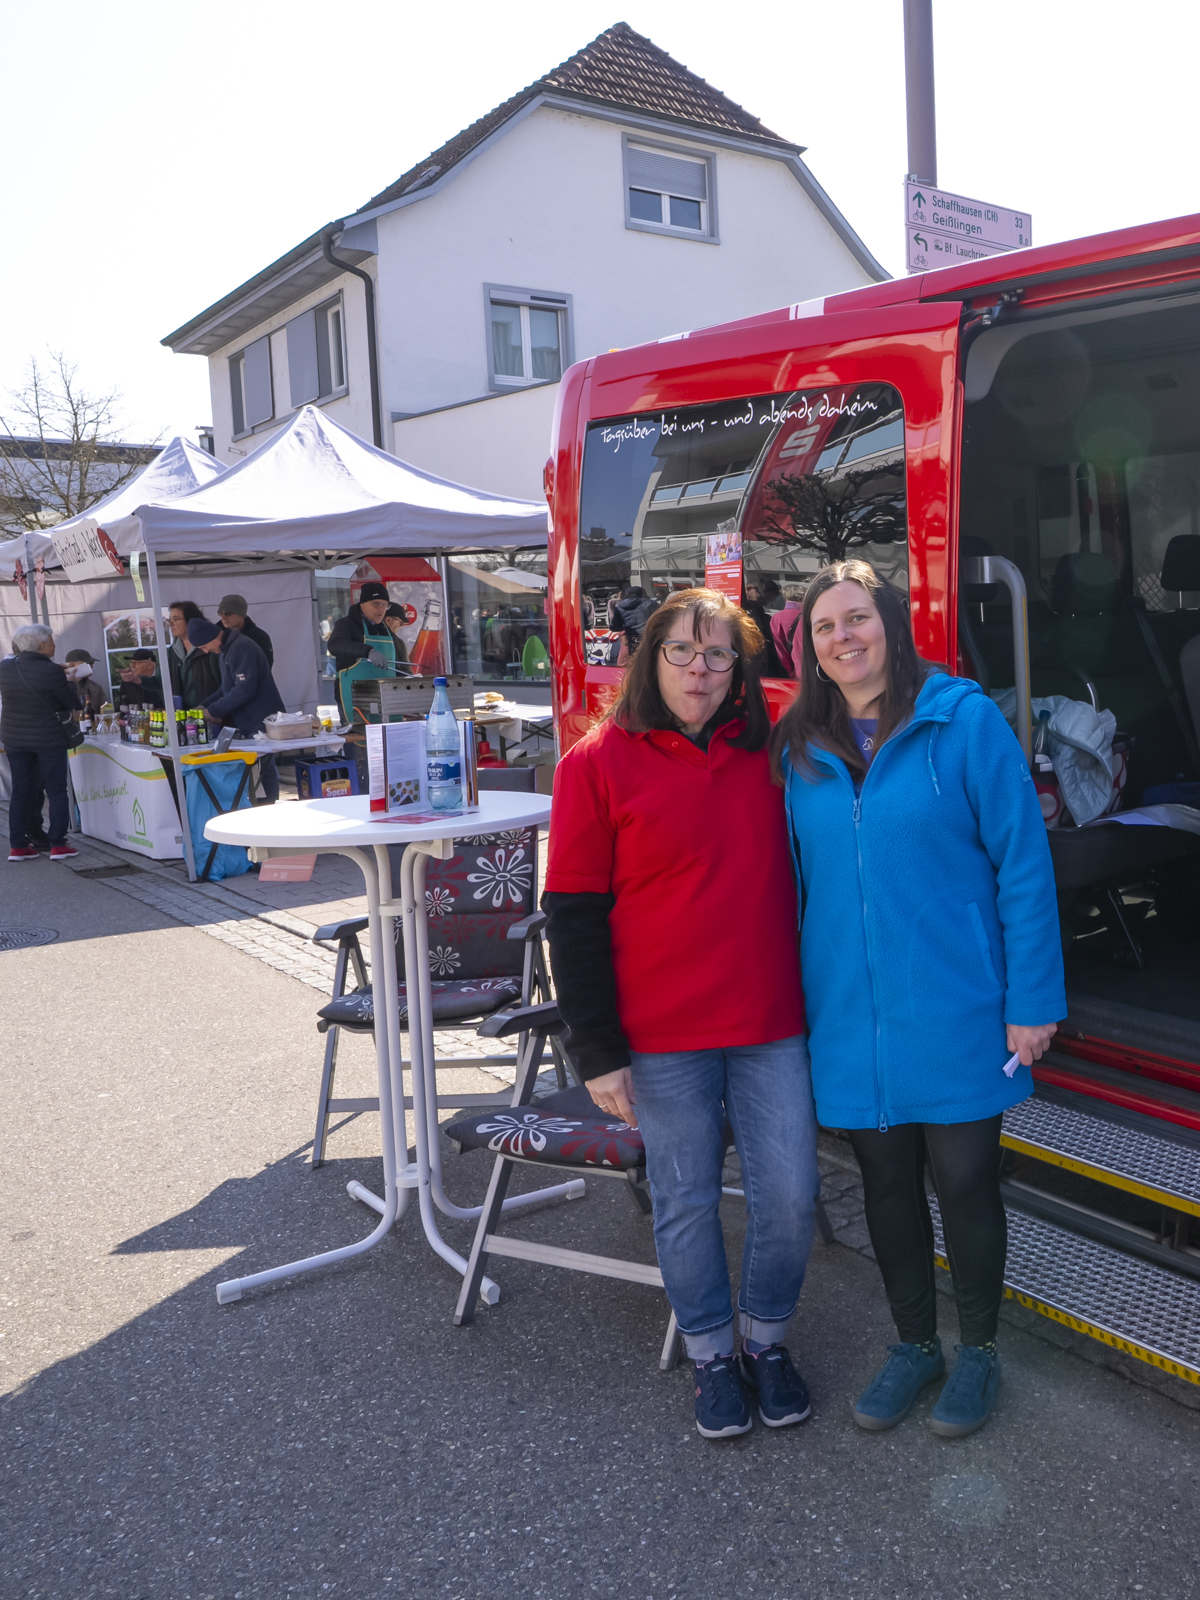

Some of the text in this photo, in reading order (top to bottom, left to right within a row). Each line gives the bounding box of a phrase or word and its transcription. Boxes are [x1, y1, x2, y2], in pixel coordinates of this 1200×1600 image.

[932, 195, 1022, 228] Schaffhausen (CH) 33
[932, 212, 982, 235] Geißlingen
[944, 242, 991, 259] Bf. Lauchrin
[662, 414, 677, 436] bei
[682, 419, 704, 433] uns
[724, 402, 754, 427] und
[759, 396, 812, 425] abends
[819, 394, 878, 418] daheim
[326, 787, 348, 797] Spezi
